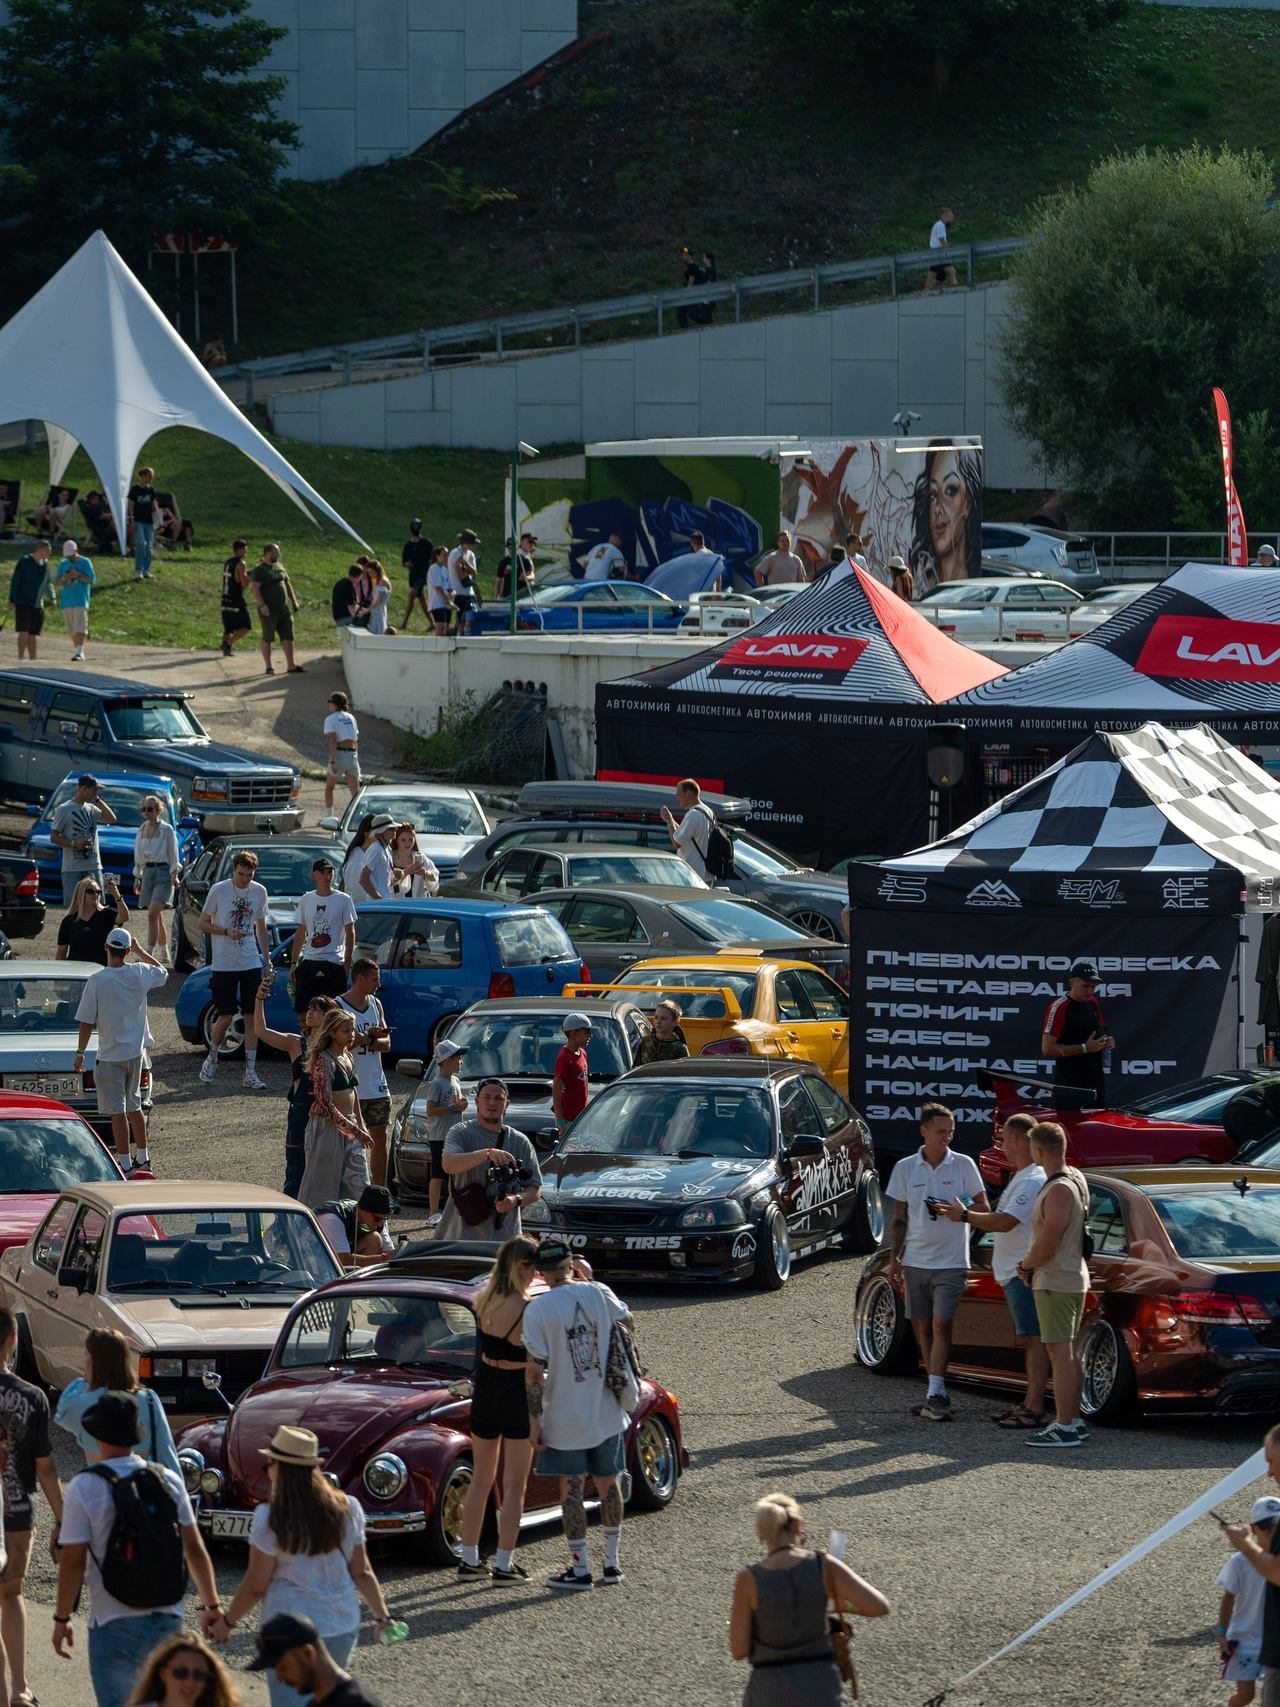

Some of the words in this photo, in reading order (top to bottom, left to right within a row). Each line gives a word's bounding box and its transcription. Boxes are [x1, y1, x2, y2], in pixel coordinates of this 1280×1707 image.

[745, 643, 838, 658] LAVR
[733, 667, 762, 678] Твое
[764, 669, 824, 680] решение
[606, 699, 670, 712] АВТОХИМИЯ
[677, 704, 741, 717] АВТОКОСМЕТИКА
[747, 708, 812, 722] АВТОХИМИЯ
[818, 713, 884, 726] АВТОКОСМЕТИКА
[1021, 719, 1088, 730] АВТОКОСМЕТИКА
[745, 811, 804, 824] решение
[1162, 877, 1209, 888] ACE
[1163, 888, 1194, 898] OF
[1163, 898, 1210, 909] ACE
[866, 1002, 1019, 1021] ТЮНИНГ
[866, 1028, 990, 1046] ЗДЕСЬ
[865, 1054, 1111, 1074] НАЧИНАЕТ
[1121, 1060, 1177, 1074] ЮГ
[573, 1187, 662, 1200] anteater
[625, 1235, 682, 1250] TIRES
